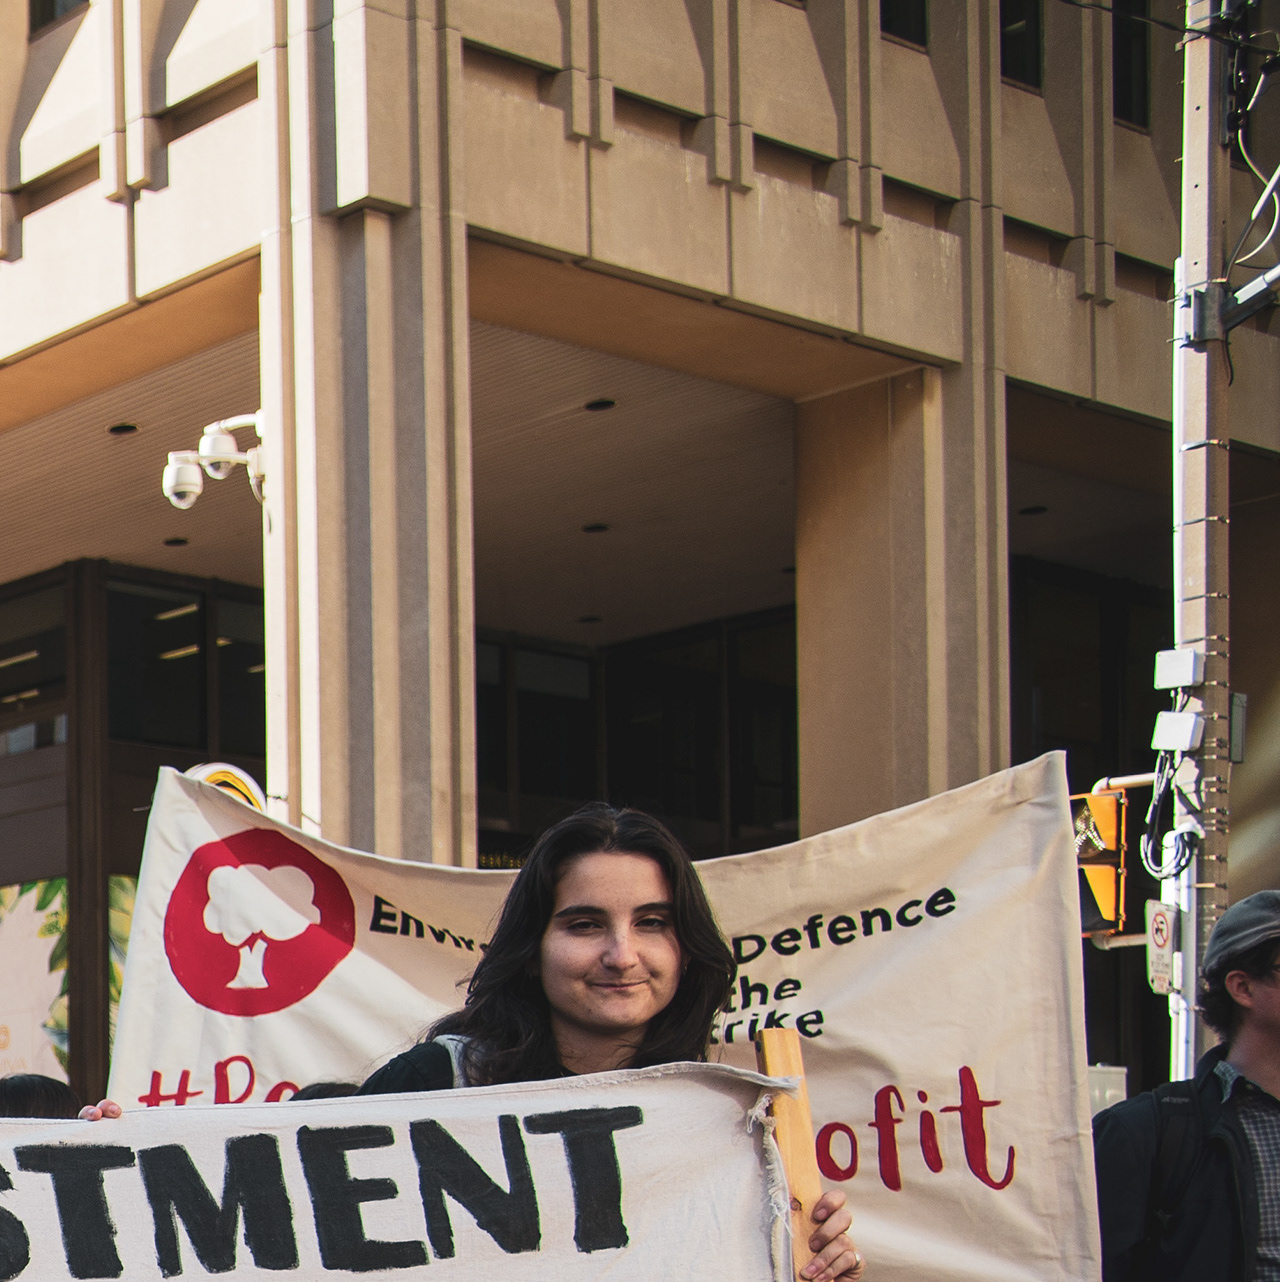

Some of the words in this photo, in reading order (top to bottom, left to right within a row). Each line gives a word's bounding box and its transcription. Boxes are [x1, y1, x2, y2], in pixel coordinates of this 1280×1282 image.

[732, 887, 957, 965] Defence
[709, 1009, 824, 1045] rike
[816, 1066, 1015, 1192] ofit
